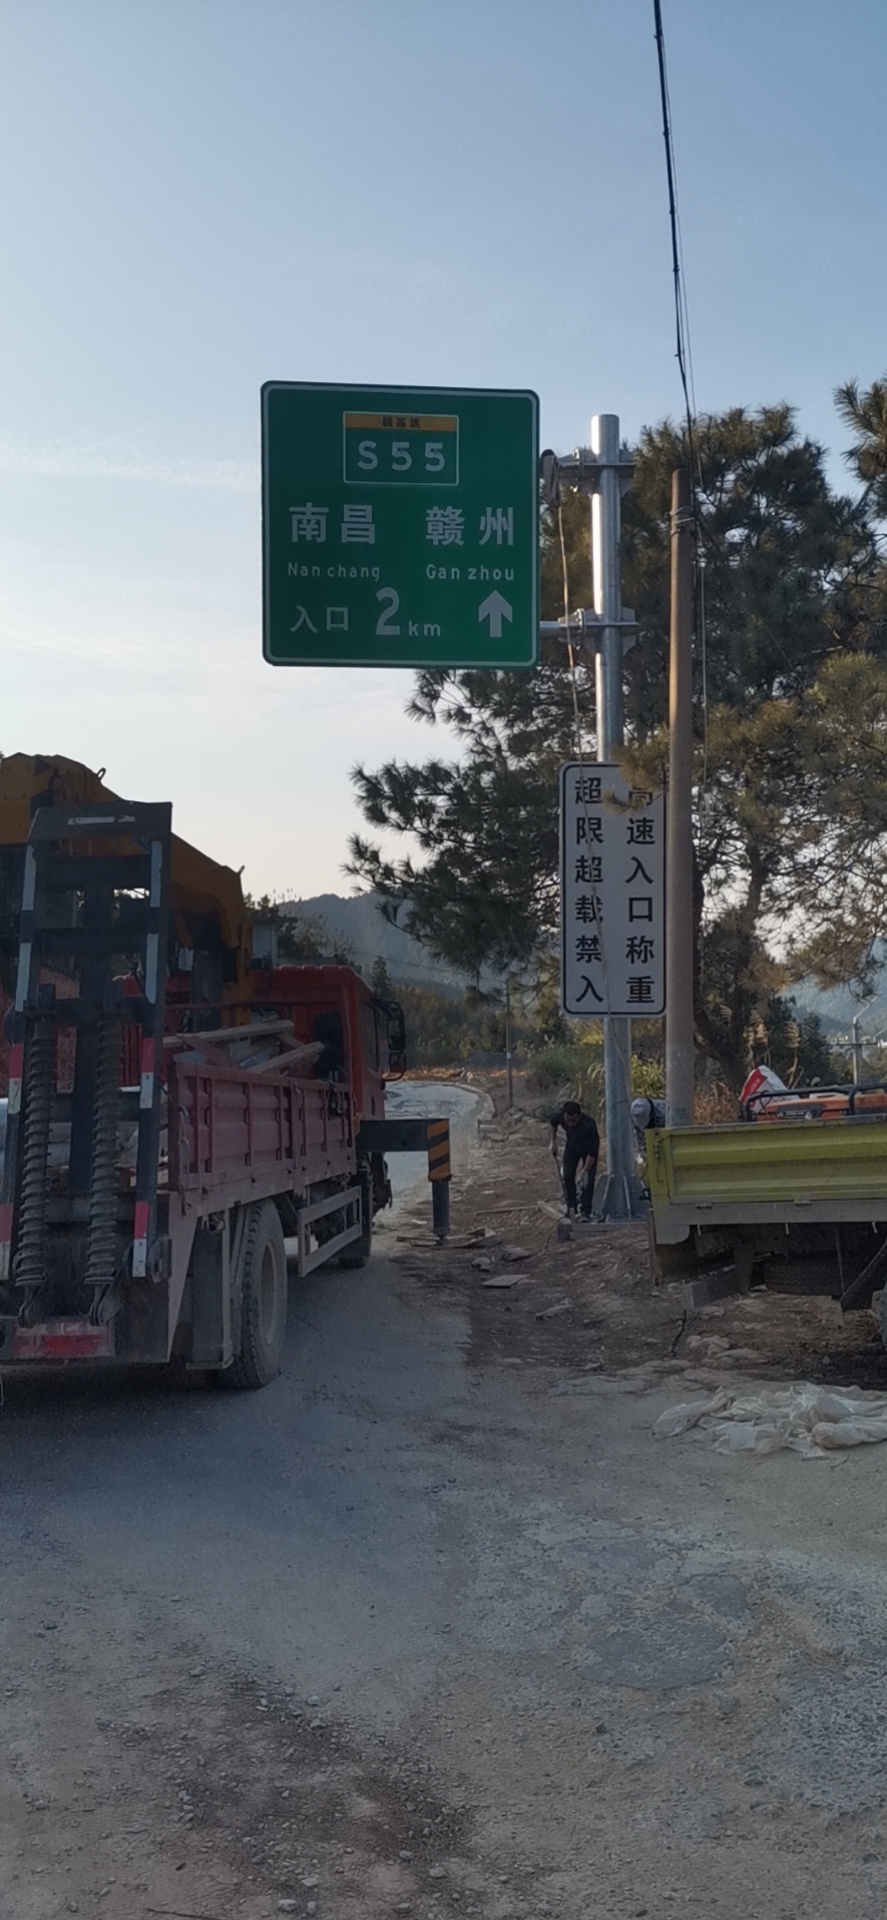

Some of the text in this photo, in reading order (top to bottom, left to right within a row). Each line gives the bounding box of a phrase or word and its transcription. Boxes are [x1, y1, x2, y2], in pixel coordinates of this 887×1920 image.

[357, 441, 446, 472] S55
[288, 502, 514, 546] 南昌 赣州
[289, 587, 441, 637] 入口 2 km
[574, 776, 604, 1003] 超限超载禁入
